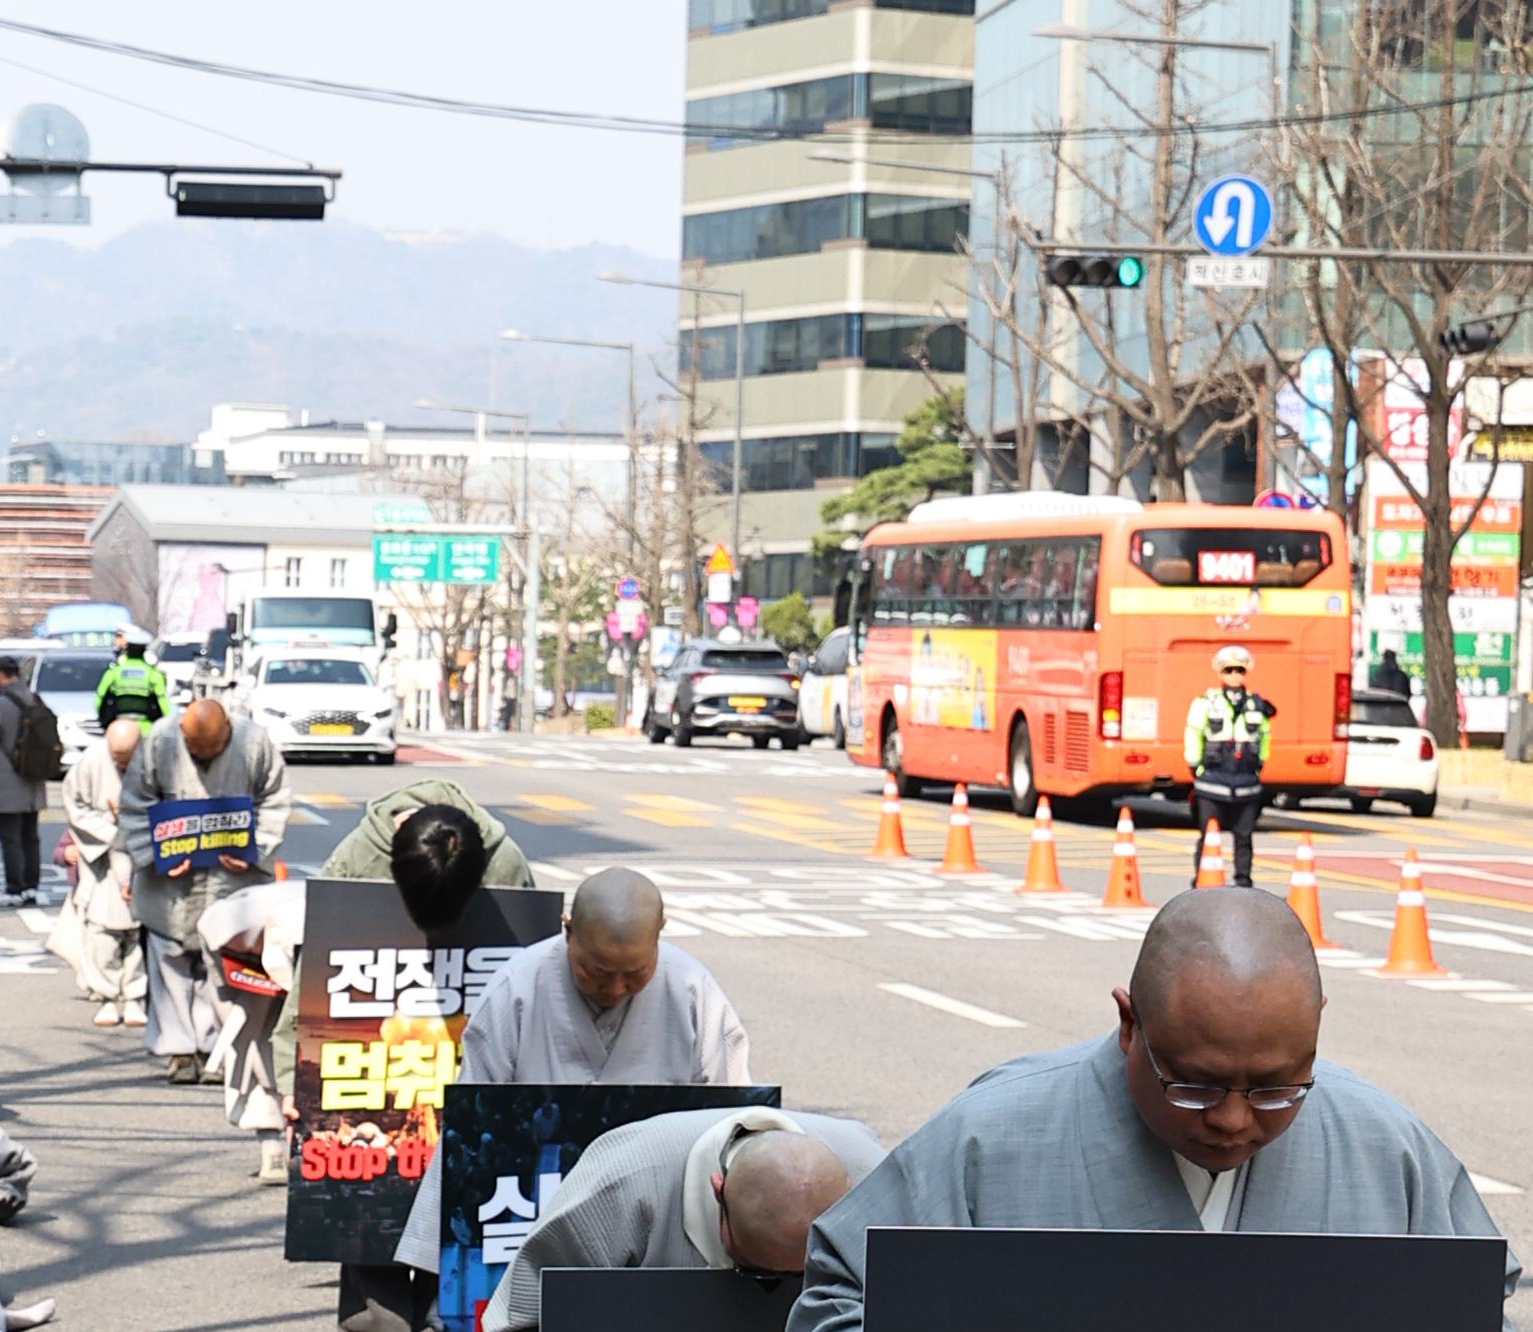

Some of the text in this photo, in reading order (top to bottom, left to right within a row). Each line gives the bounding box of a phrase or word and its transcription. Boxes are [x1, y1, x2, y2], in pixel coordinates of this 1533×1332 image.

[1201, 553, 1253, 581] 9401
[200, 830, 250, 850] killing
[320, 1040, 458, 1111] 멈춰
[301, 1139, 434, 1181] Stop th
